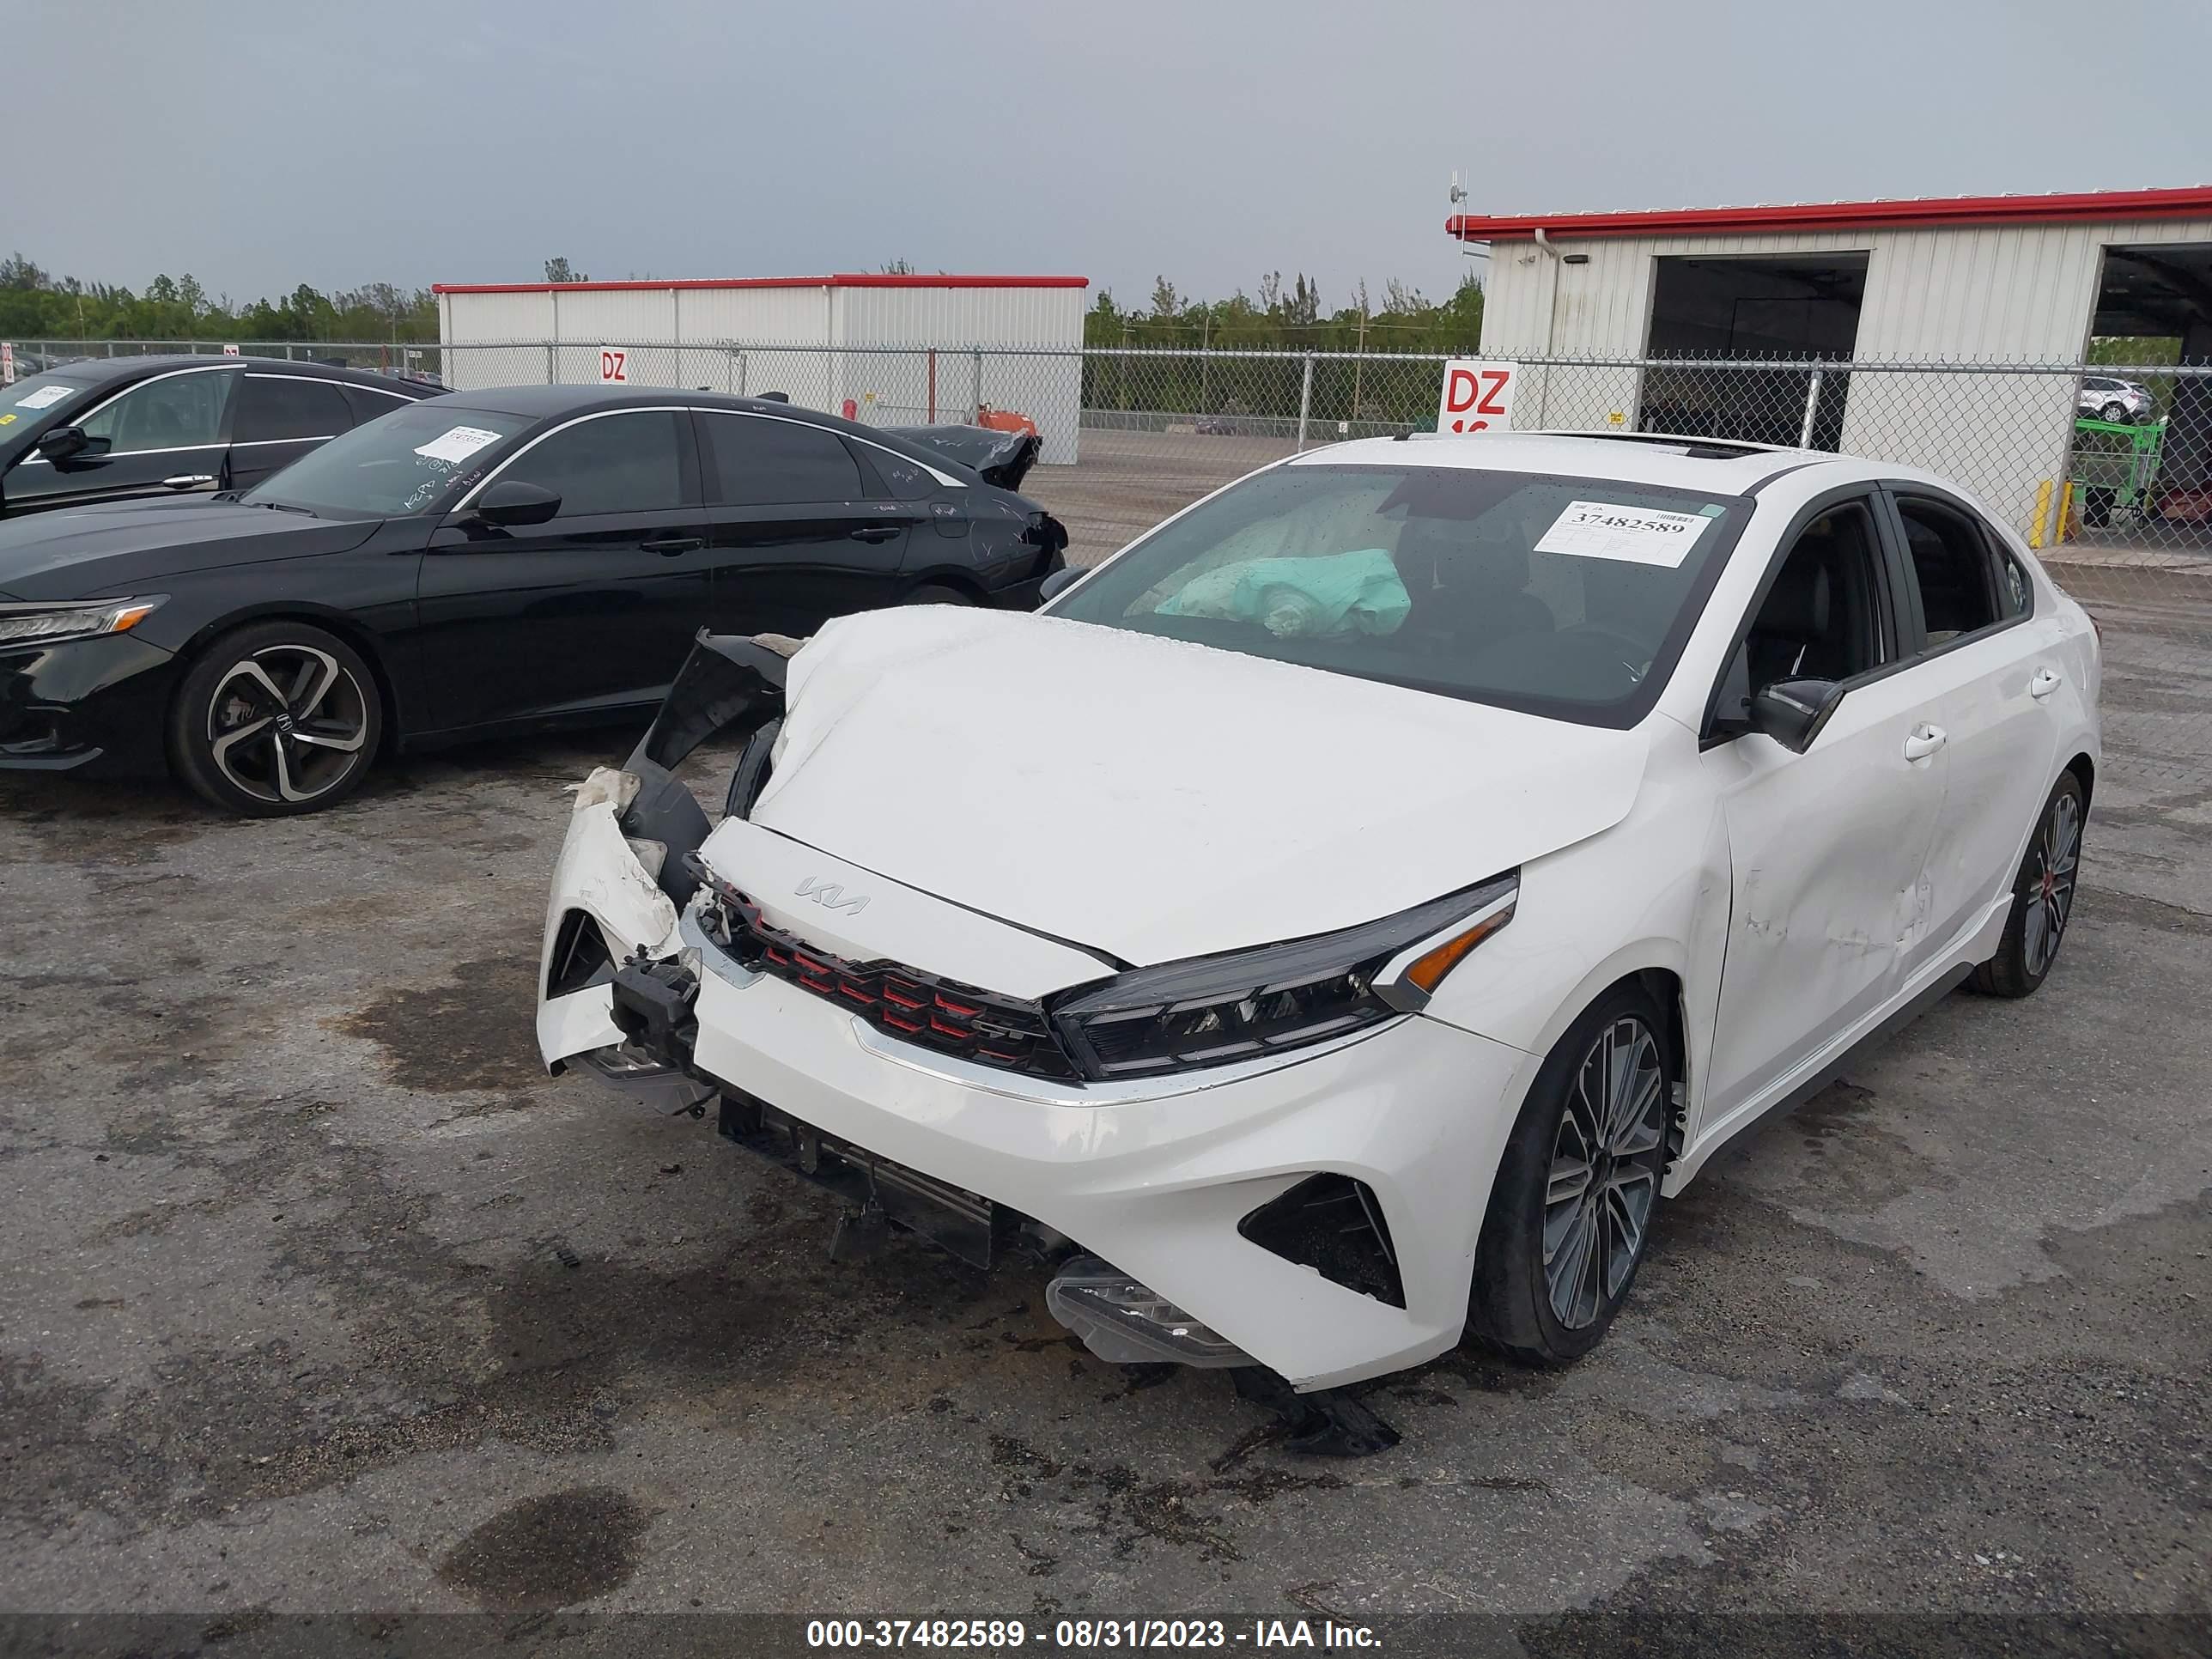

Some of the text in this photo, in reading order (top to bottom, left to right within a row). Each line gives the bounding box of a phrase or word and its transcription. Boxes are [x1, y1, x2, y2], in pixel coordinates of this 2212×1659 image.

[603, 352, 625, 380] DZ
[1447, 369, 1510, 414] DZ
[1571, 513, 1685, 534] 37482589
[793, 874, 872, 916] KIA
